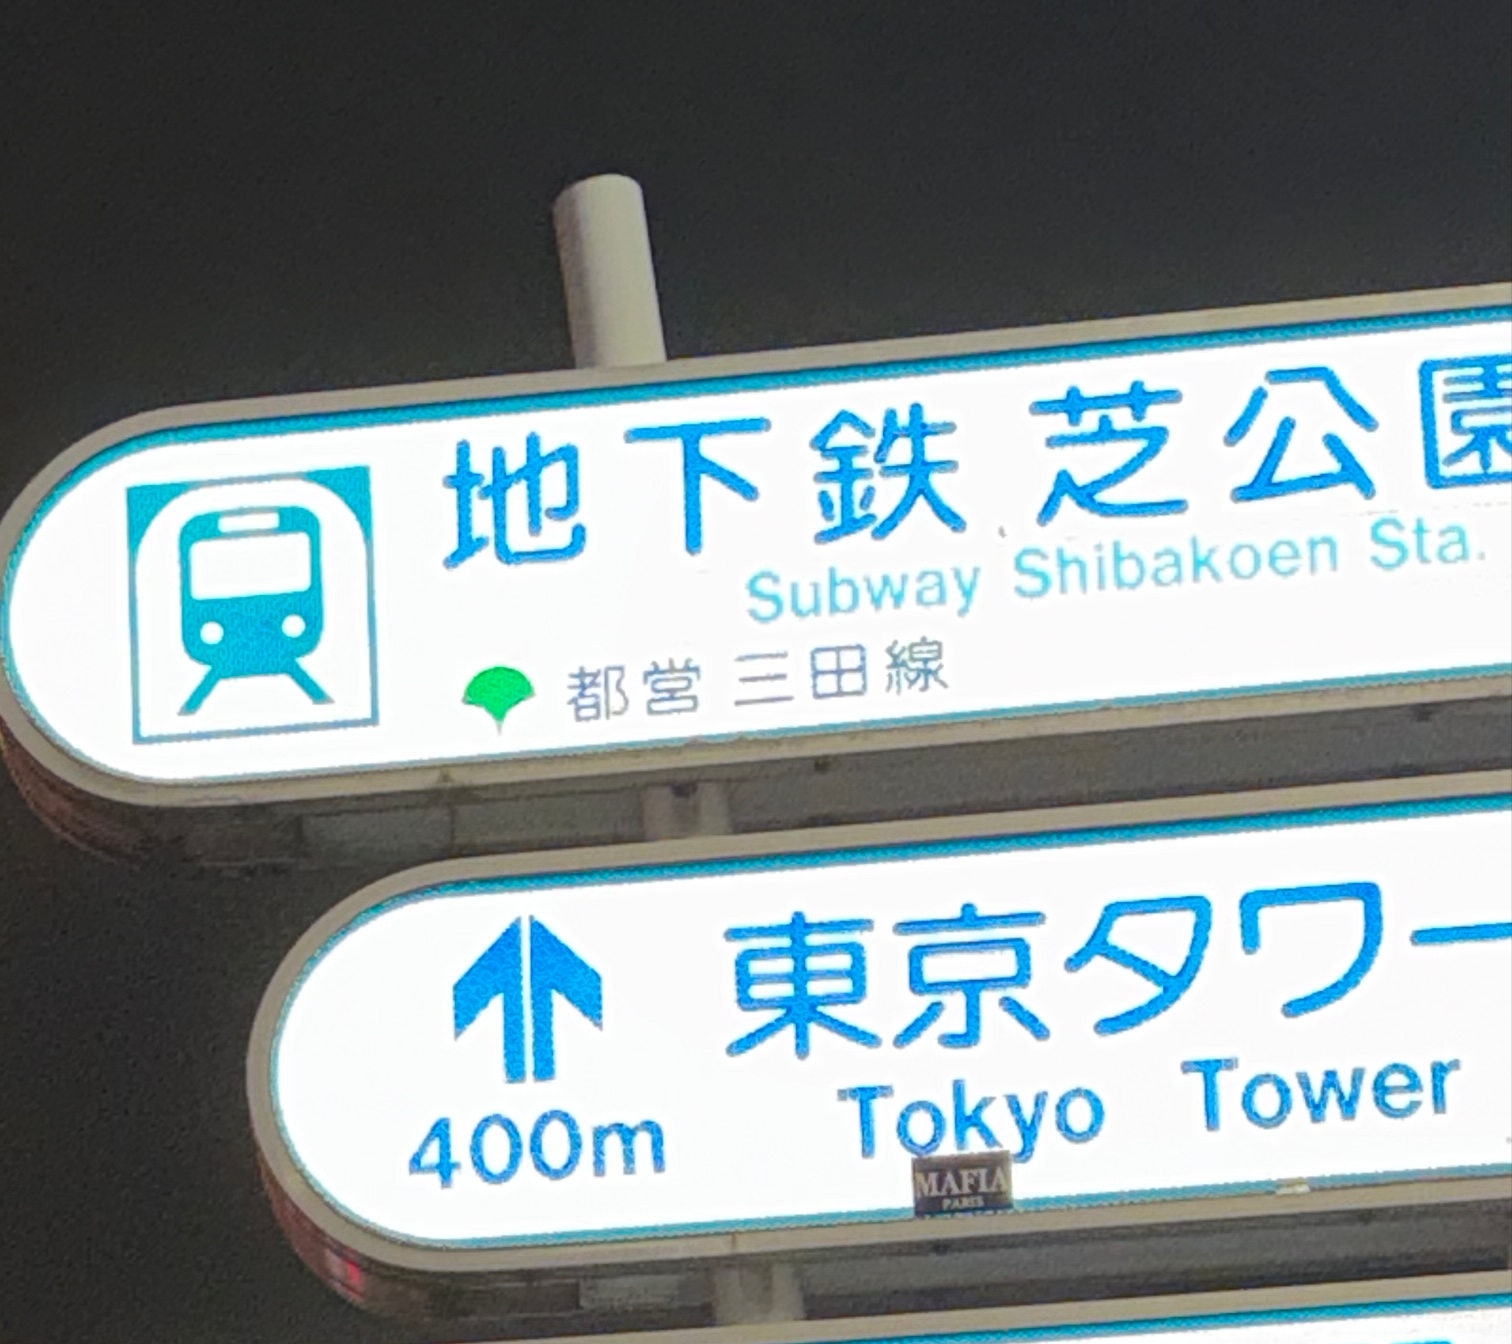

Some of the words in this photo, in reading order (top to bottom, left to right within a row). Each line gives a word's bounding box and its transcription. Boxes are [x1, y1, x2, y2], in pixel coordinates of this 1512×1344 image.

[747, 563, 980, 623] Subway
[1015, 536, 1337, 598] Shibakoen
[1371, 517, 1485, 571] Sta.
[723, 881, 1512, 1060] 東京タワー
[409, 1109, 666, 1189] 400m
[837, 1079, 1105, 1163] Tokyo
[1181, 1057, 1460, 1131] Tower
[915, 1167, 1008, 1197] MAFIA
